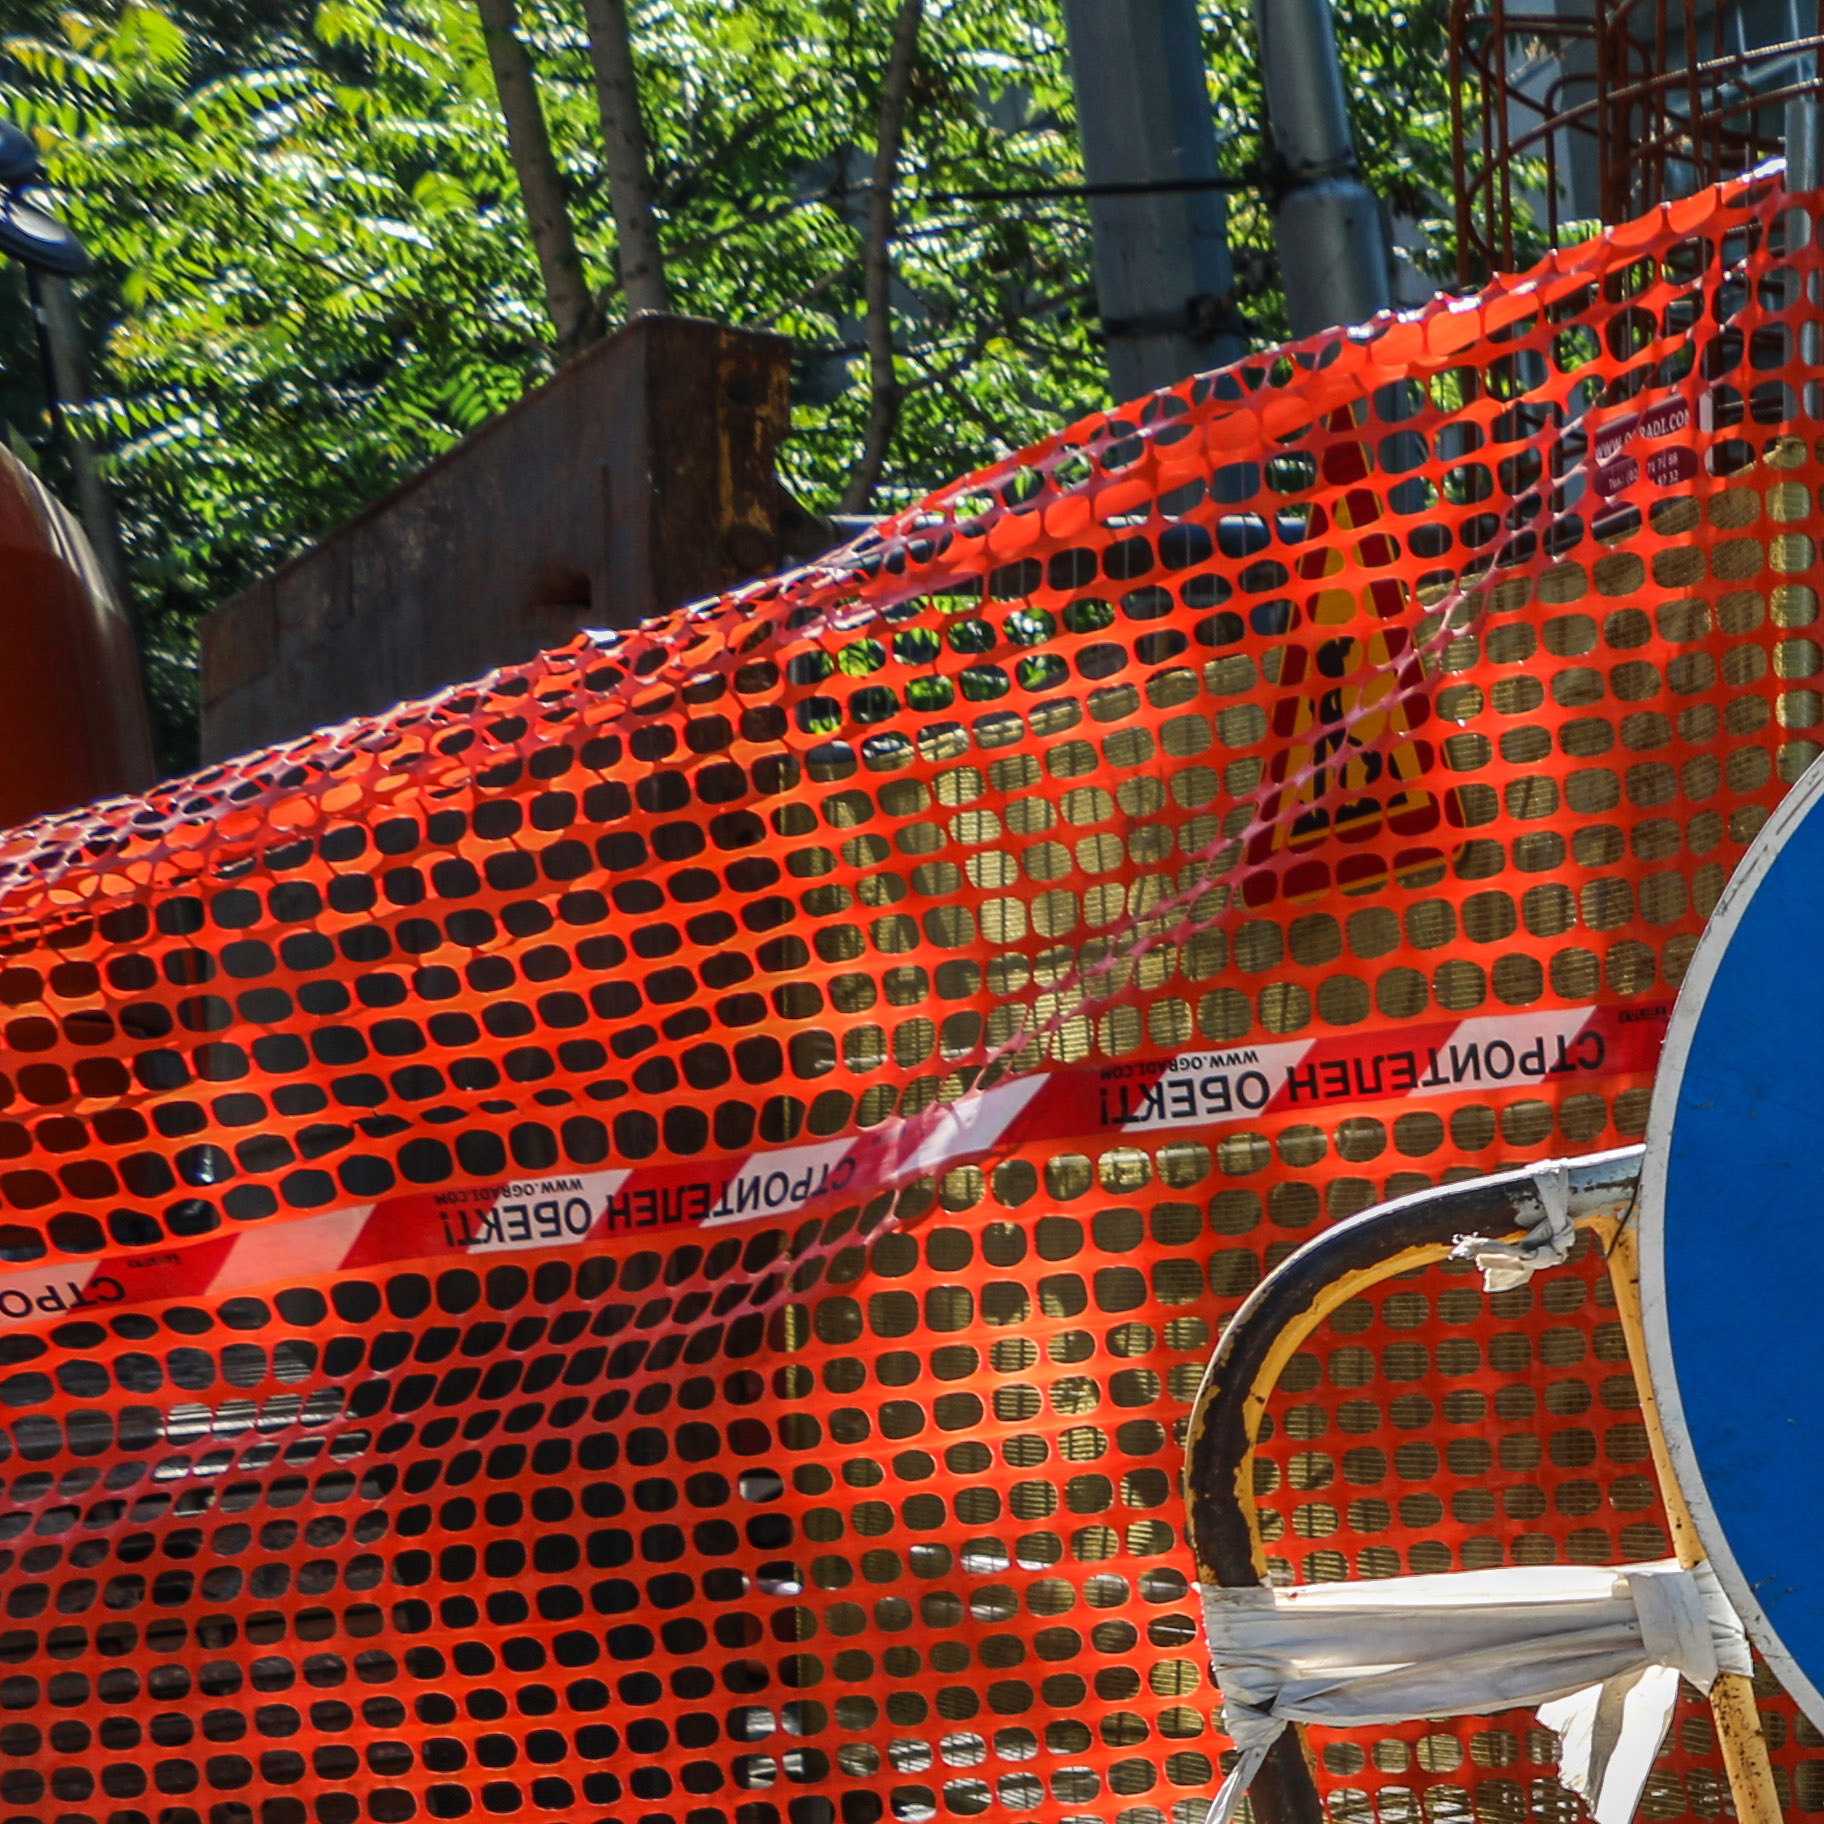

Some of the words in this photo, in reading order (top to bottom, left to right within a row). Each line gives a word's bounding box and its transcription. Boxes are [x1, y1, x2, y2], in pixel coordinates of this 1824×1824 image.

[1100, 1050, 1259, 1081] WWW.OGRADI.COM
[1285, 1030, 1605, 1103] СТРОИТЕЛЕН
[1099, 1070, 1270, 1126] ОБЕКТ!
[434, 1178, 584, 1205] WWW.OGRADI.COM
[606, 1156, 857, 1231] СТРОИТЕЛЕН
[440, 1197, 592, 1247] ОБЕКТ!
